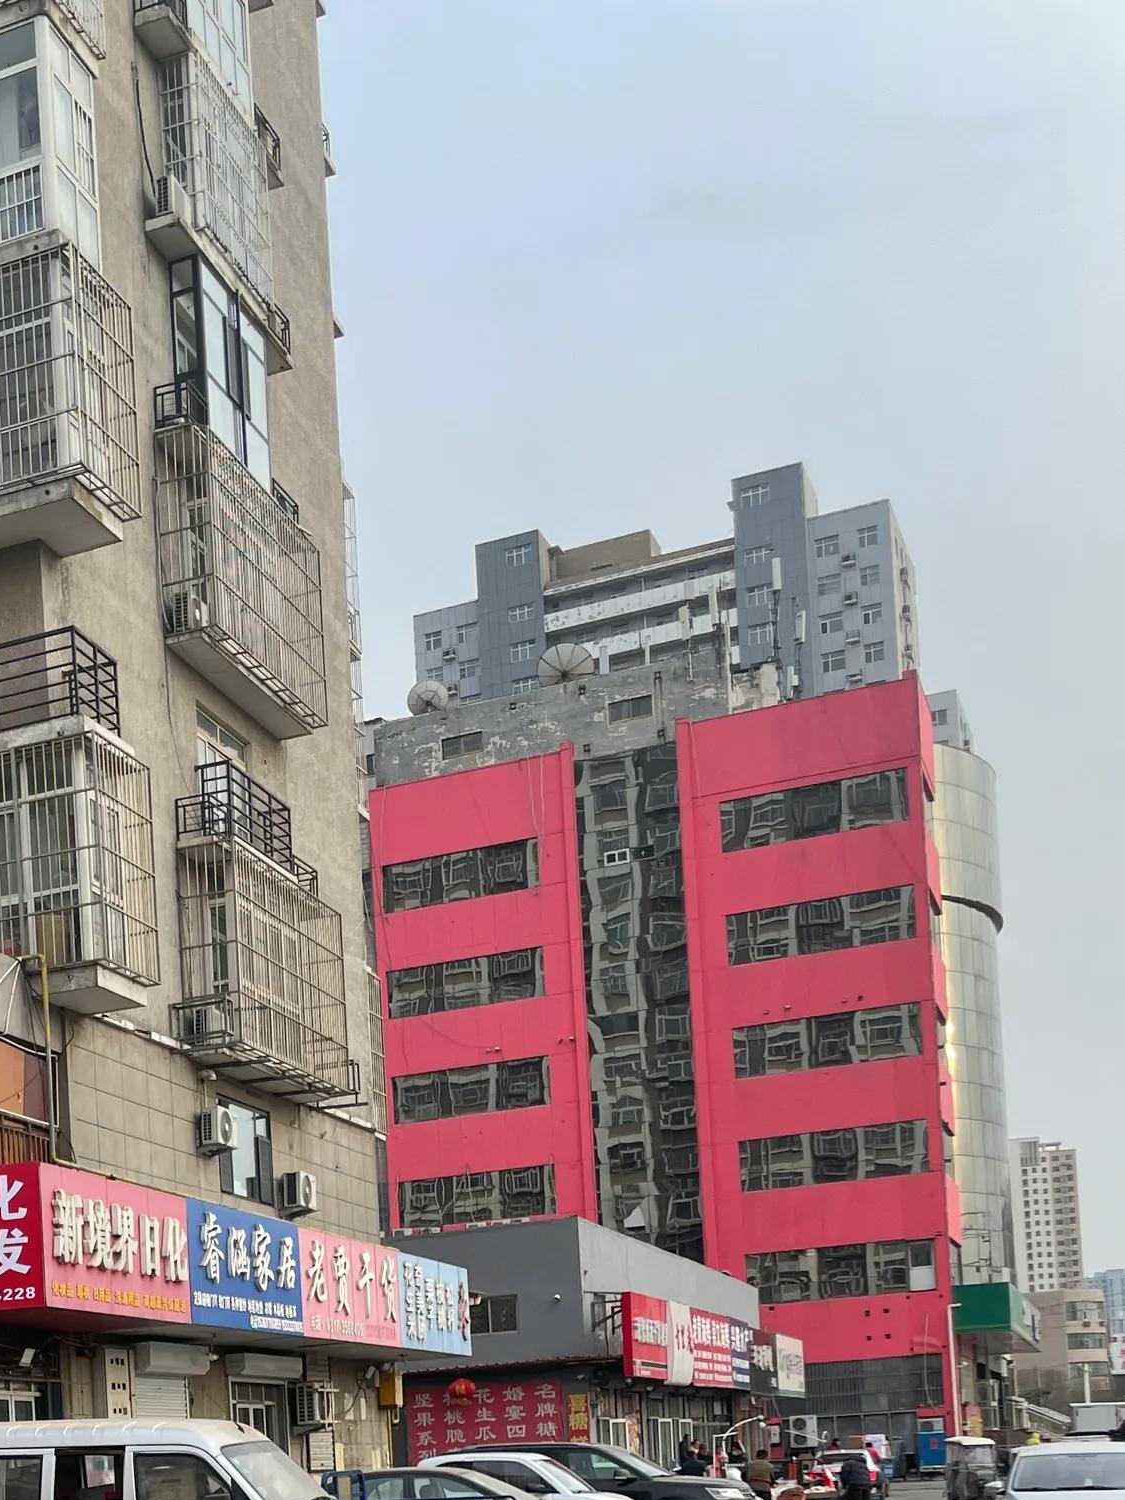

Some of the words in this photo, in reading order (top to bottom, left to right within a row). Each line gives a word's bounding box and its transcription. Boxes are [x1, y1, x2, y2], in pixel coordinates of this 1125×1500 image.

[52, 1188, 187, 1283] 新境界日化
[444, 1391, 466, 1453] 桃脆
[534, 1383, 558, 1443] 名牌糖
